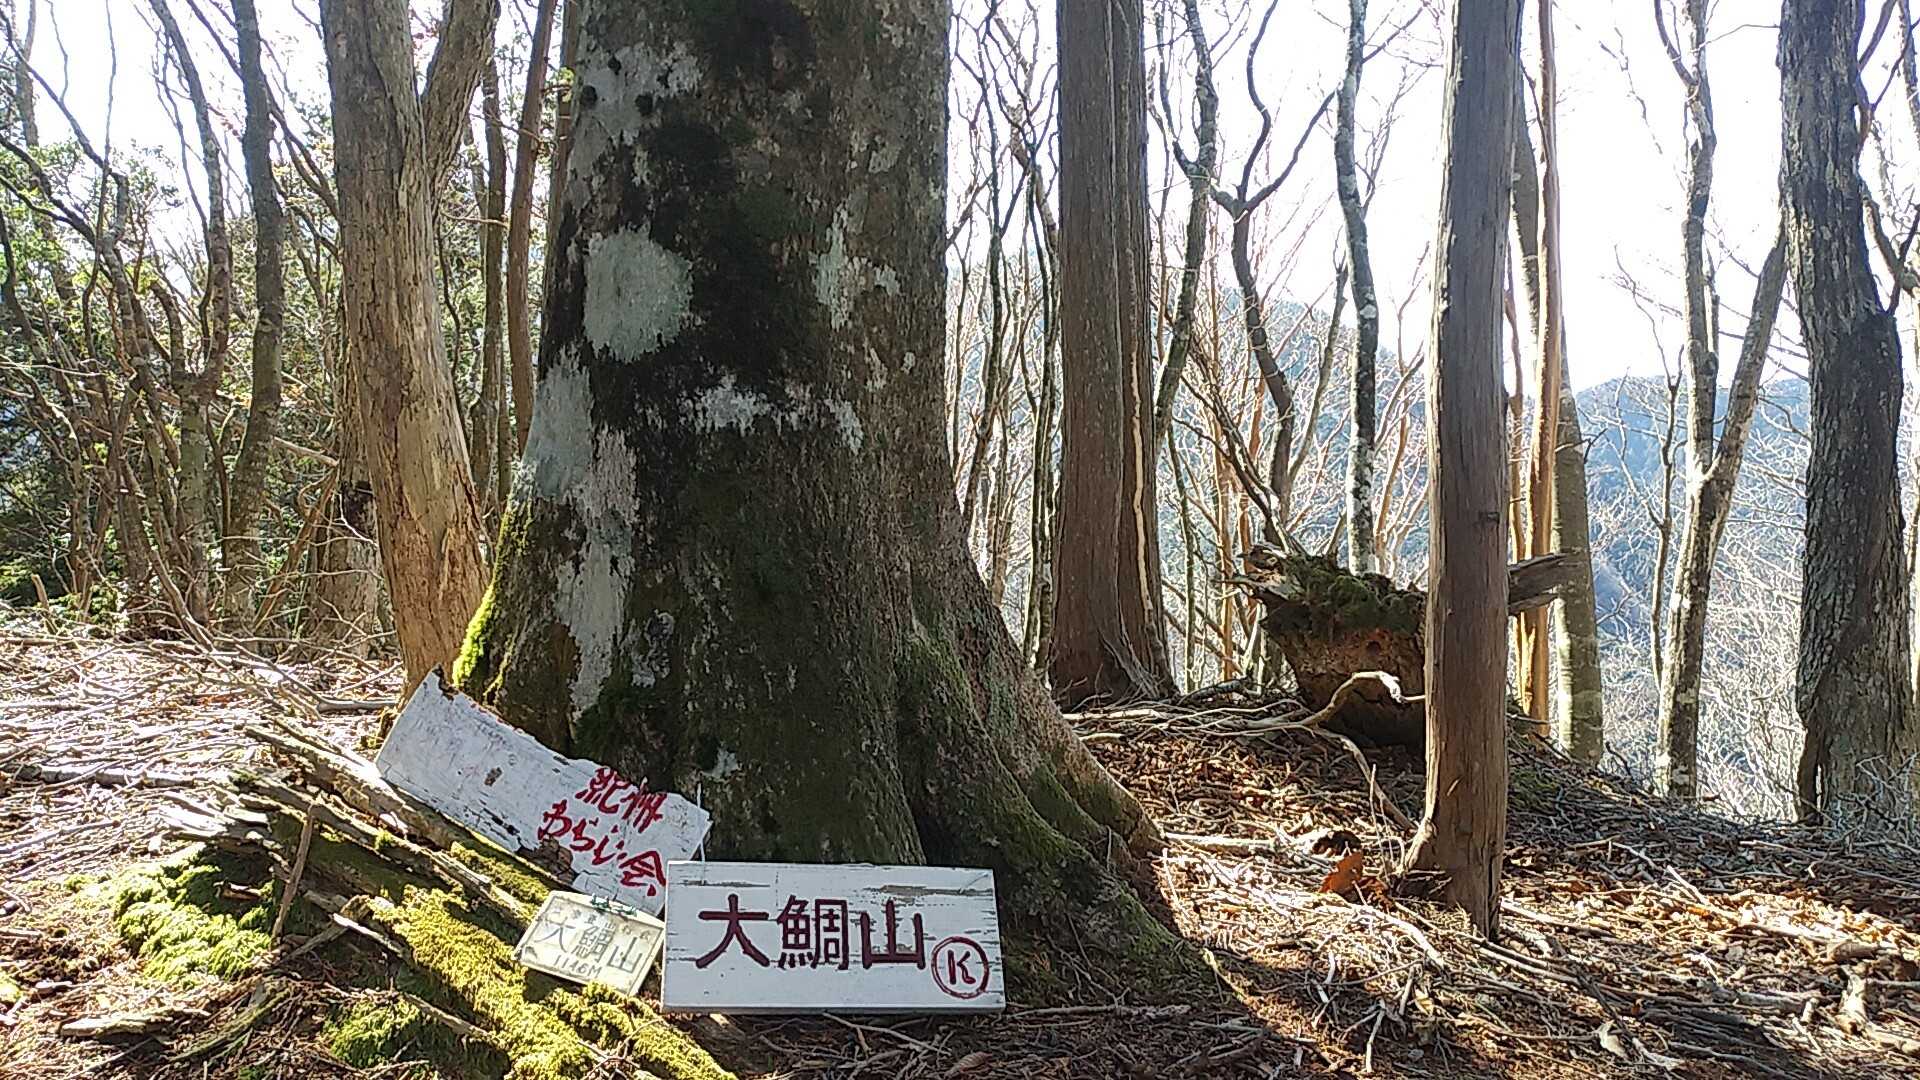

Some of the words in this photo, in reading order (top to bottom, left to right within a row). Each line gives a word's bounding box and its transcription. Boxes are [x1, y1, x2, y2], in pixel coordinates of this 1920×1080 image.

[534, 916, 643, 974] 大鯛山
[695, 894, 926, 970] 大鯛山
